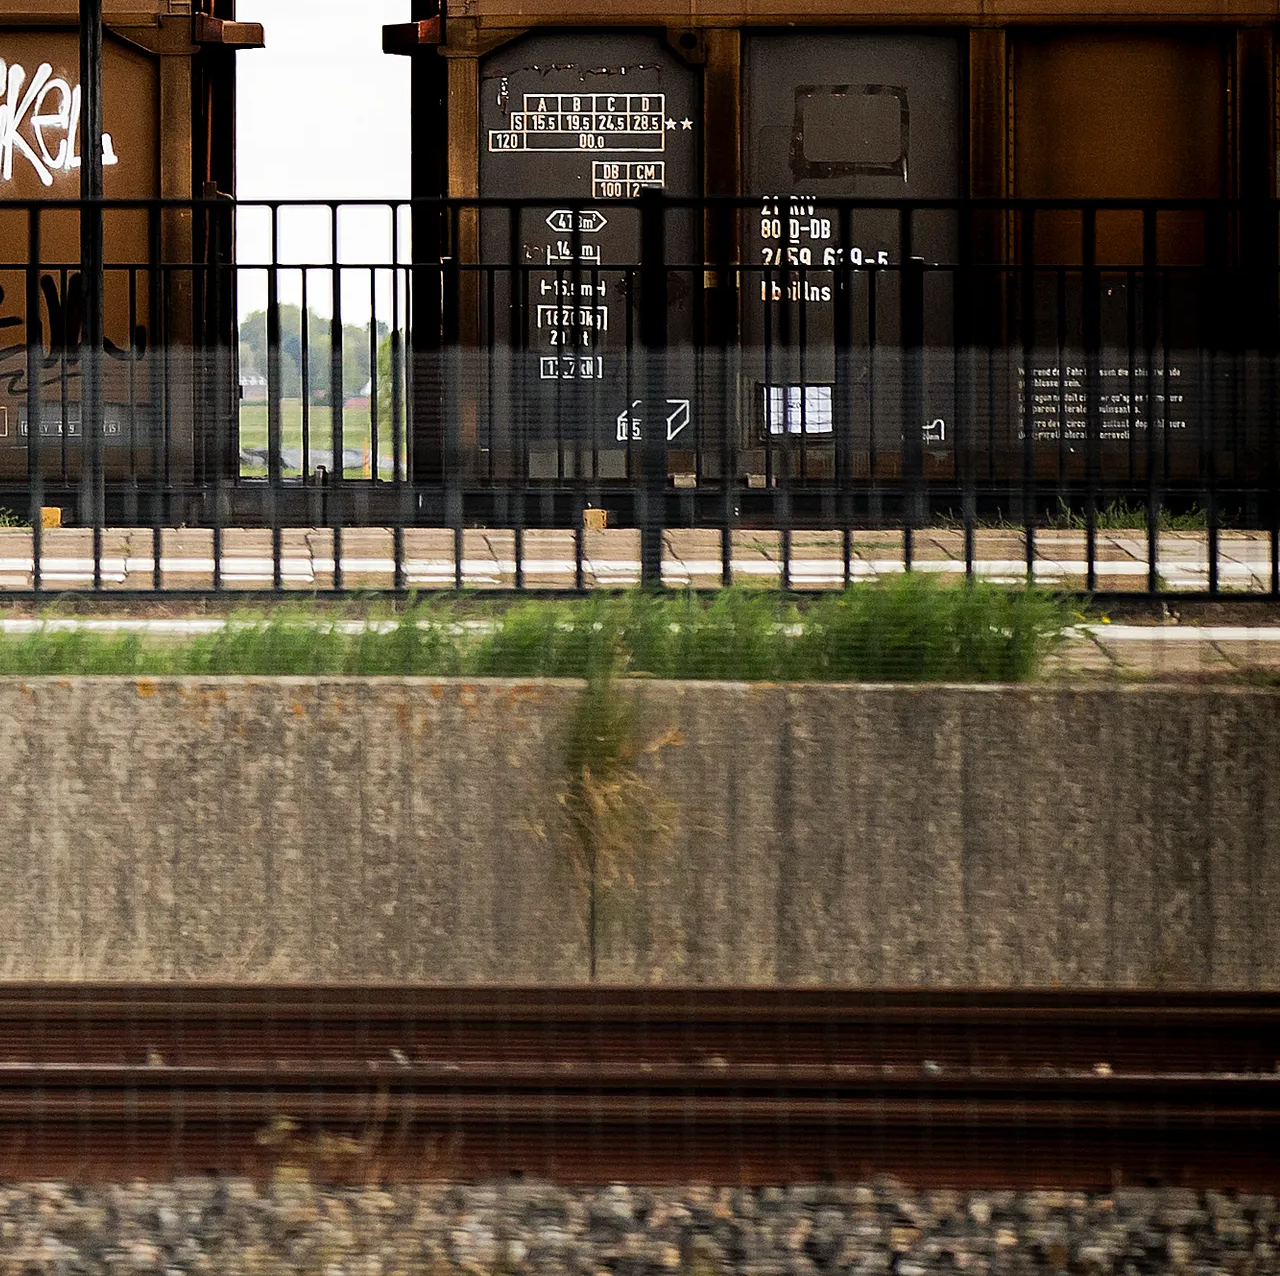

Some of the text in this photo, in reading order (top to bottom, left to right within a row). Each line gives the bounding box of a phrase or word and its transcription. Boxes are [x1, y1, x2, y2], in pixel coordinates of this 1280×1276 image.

[538, 97, 650, 112] A B C D
[514, 115, 659, 130] S 15.5 19.5 24.5 28.5
[496, 133, 518, 149] 120
[603, 165, 655, 180] DB CM
[600, 183, 622, 198] 100
[760, 218, 831, 241] 80 D-DB
